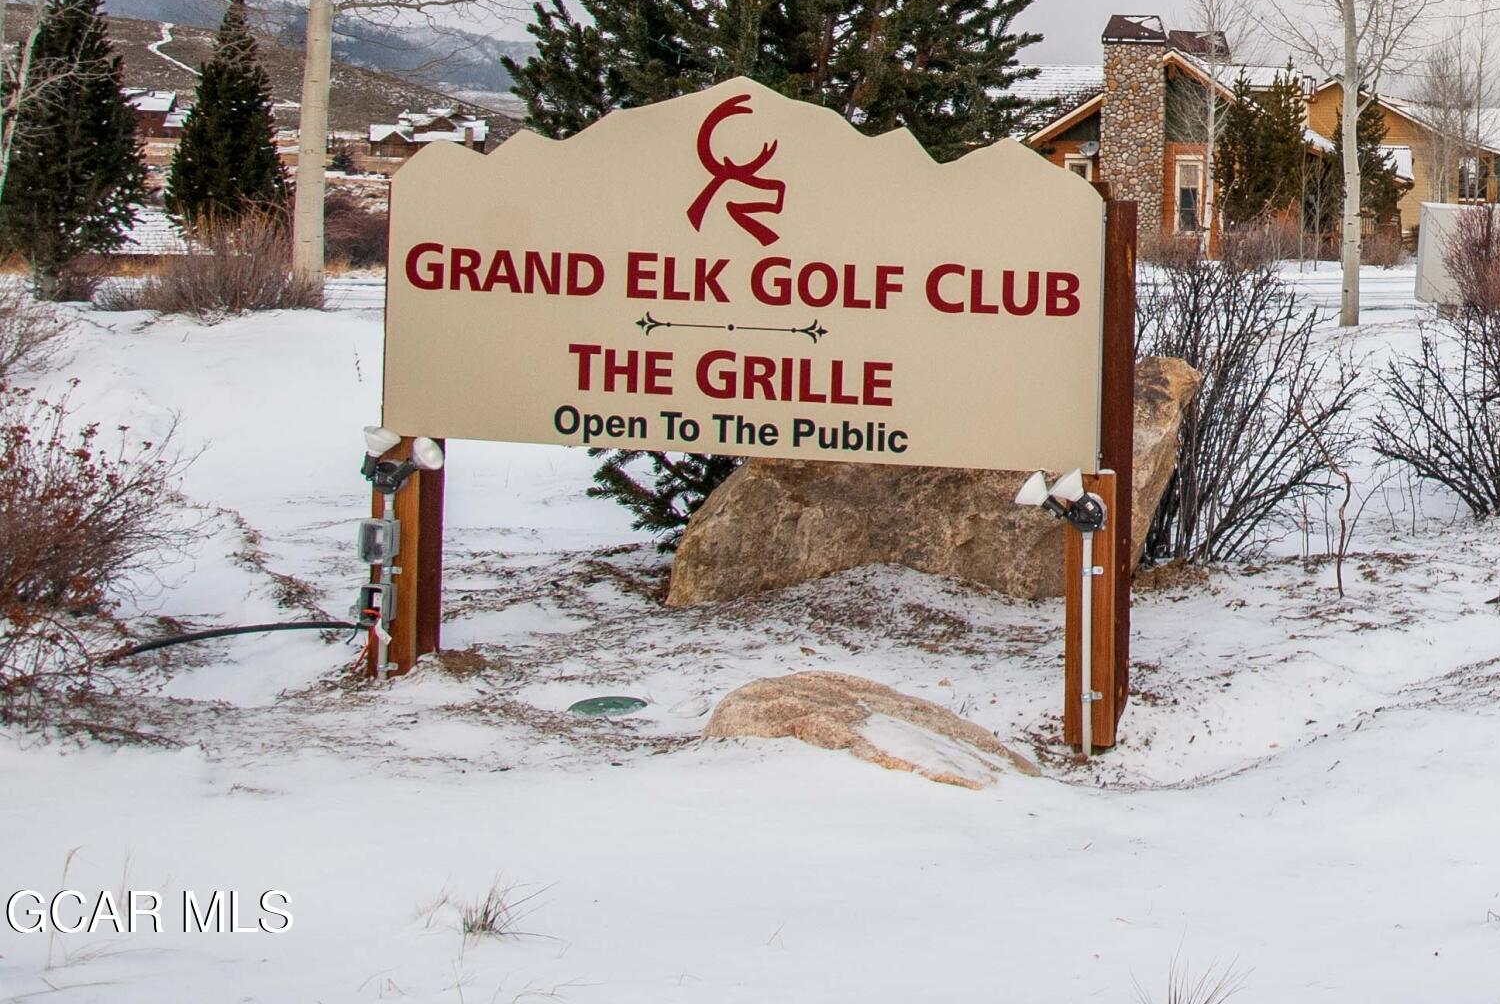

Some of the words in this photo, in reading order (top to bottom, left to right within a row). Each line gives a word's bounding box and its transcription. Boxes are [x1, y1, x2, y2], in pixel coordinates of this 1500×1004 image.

[404, 242, 605, 296] GRAND
[626, 252, 730, 303] ELK
[750, 256, 904, 310] GOLF
[925, 263, 1081, 317] CLUB
[568, 343, 673, 395] THE
[695, 349, 893, 407] GRILLE
[553, 404, 647, 443] Open
[659, 410, 700, 442] To
[711, 413, 780, 446] The
[792, 417, 909, 454] Public
